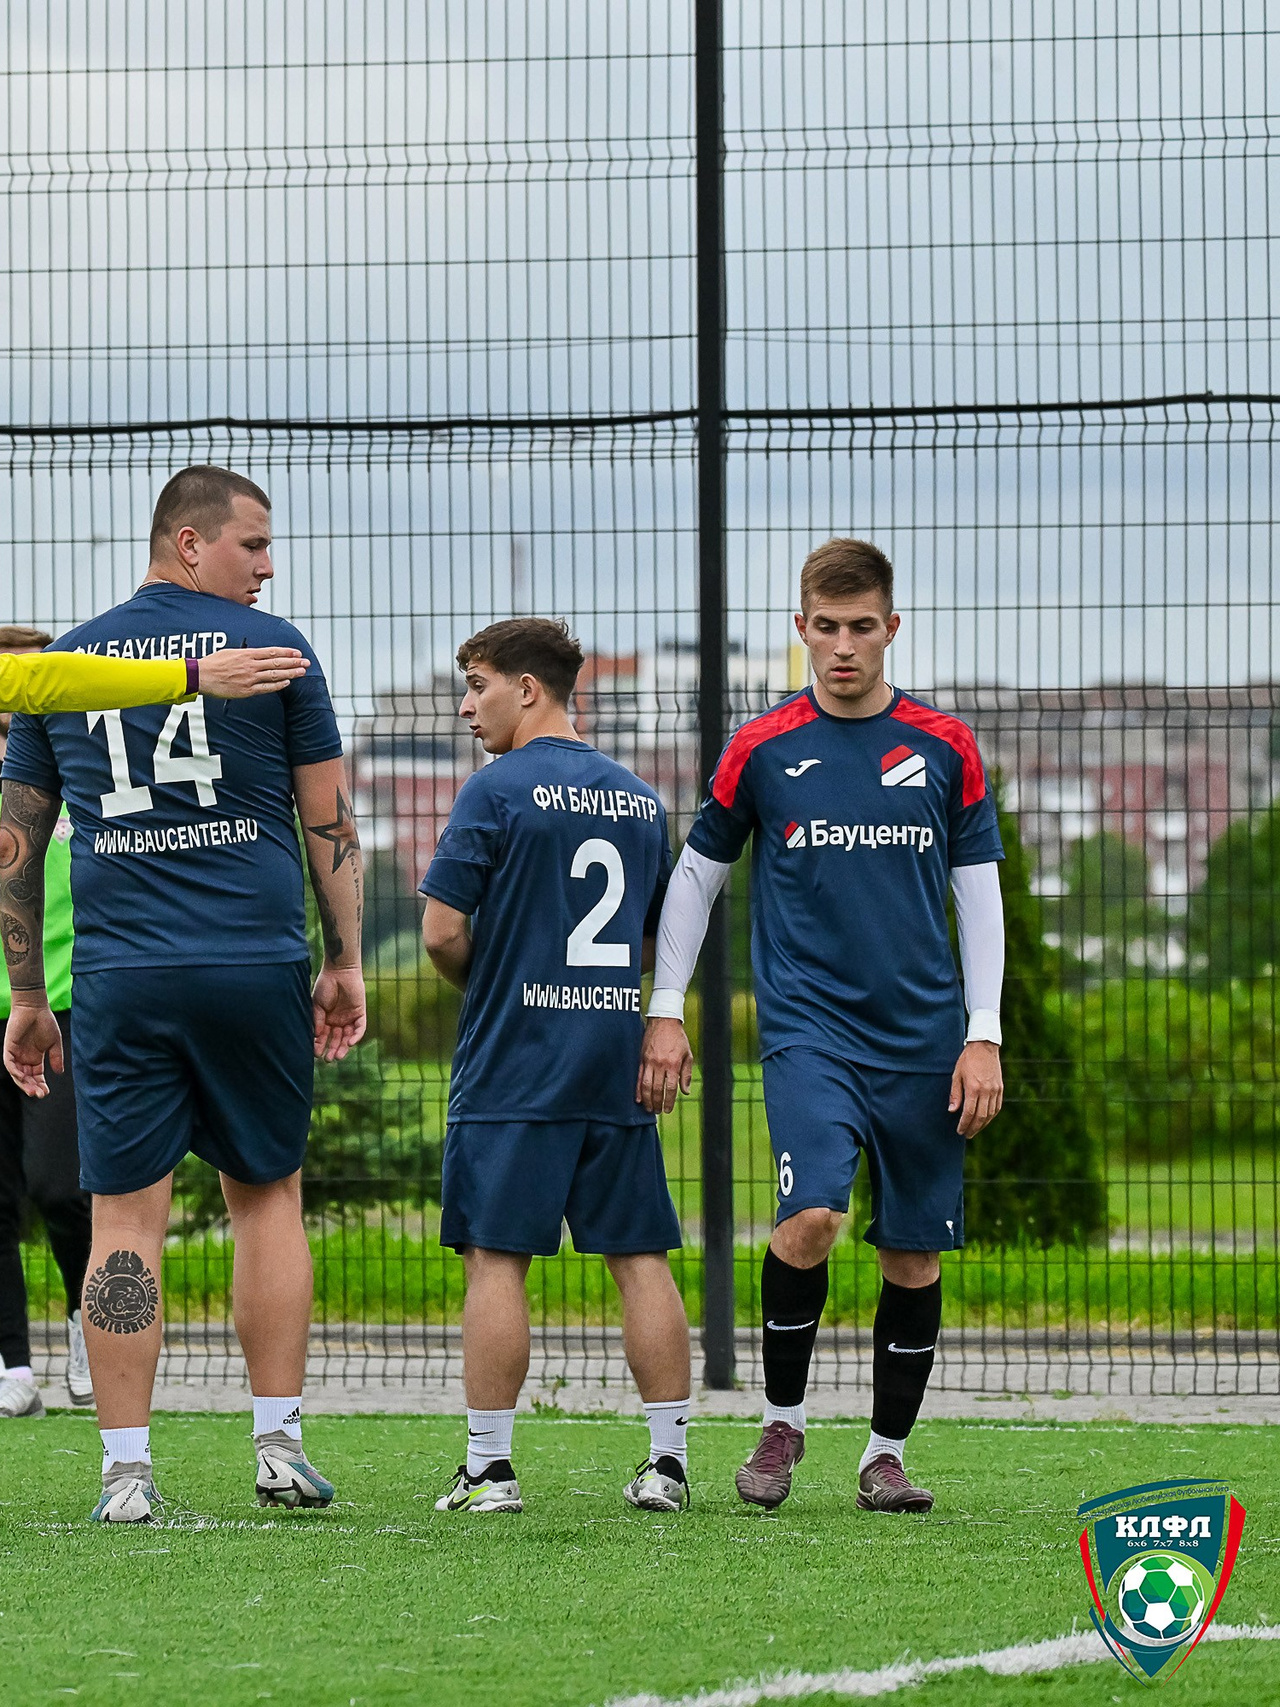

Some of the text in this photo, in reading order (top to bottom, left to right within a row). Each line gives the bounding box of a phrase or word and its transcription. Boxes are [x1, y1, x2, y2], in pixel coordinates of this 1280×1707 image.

[86, 694, 223, 819] 14
[532, 784, 658, 822] ФК БАУЦЕНТР
[94, 818, 259, 854] WWW.BAUCENTER.RU
[810, 820, 934, 853] Бауцентр
[566, 838, 631, 967] 2
[779, 1151, 794, 1197] 6
[84, 1266, 159, 1305] BOYS FROM
